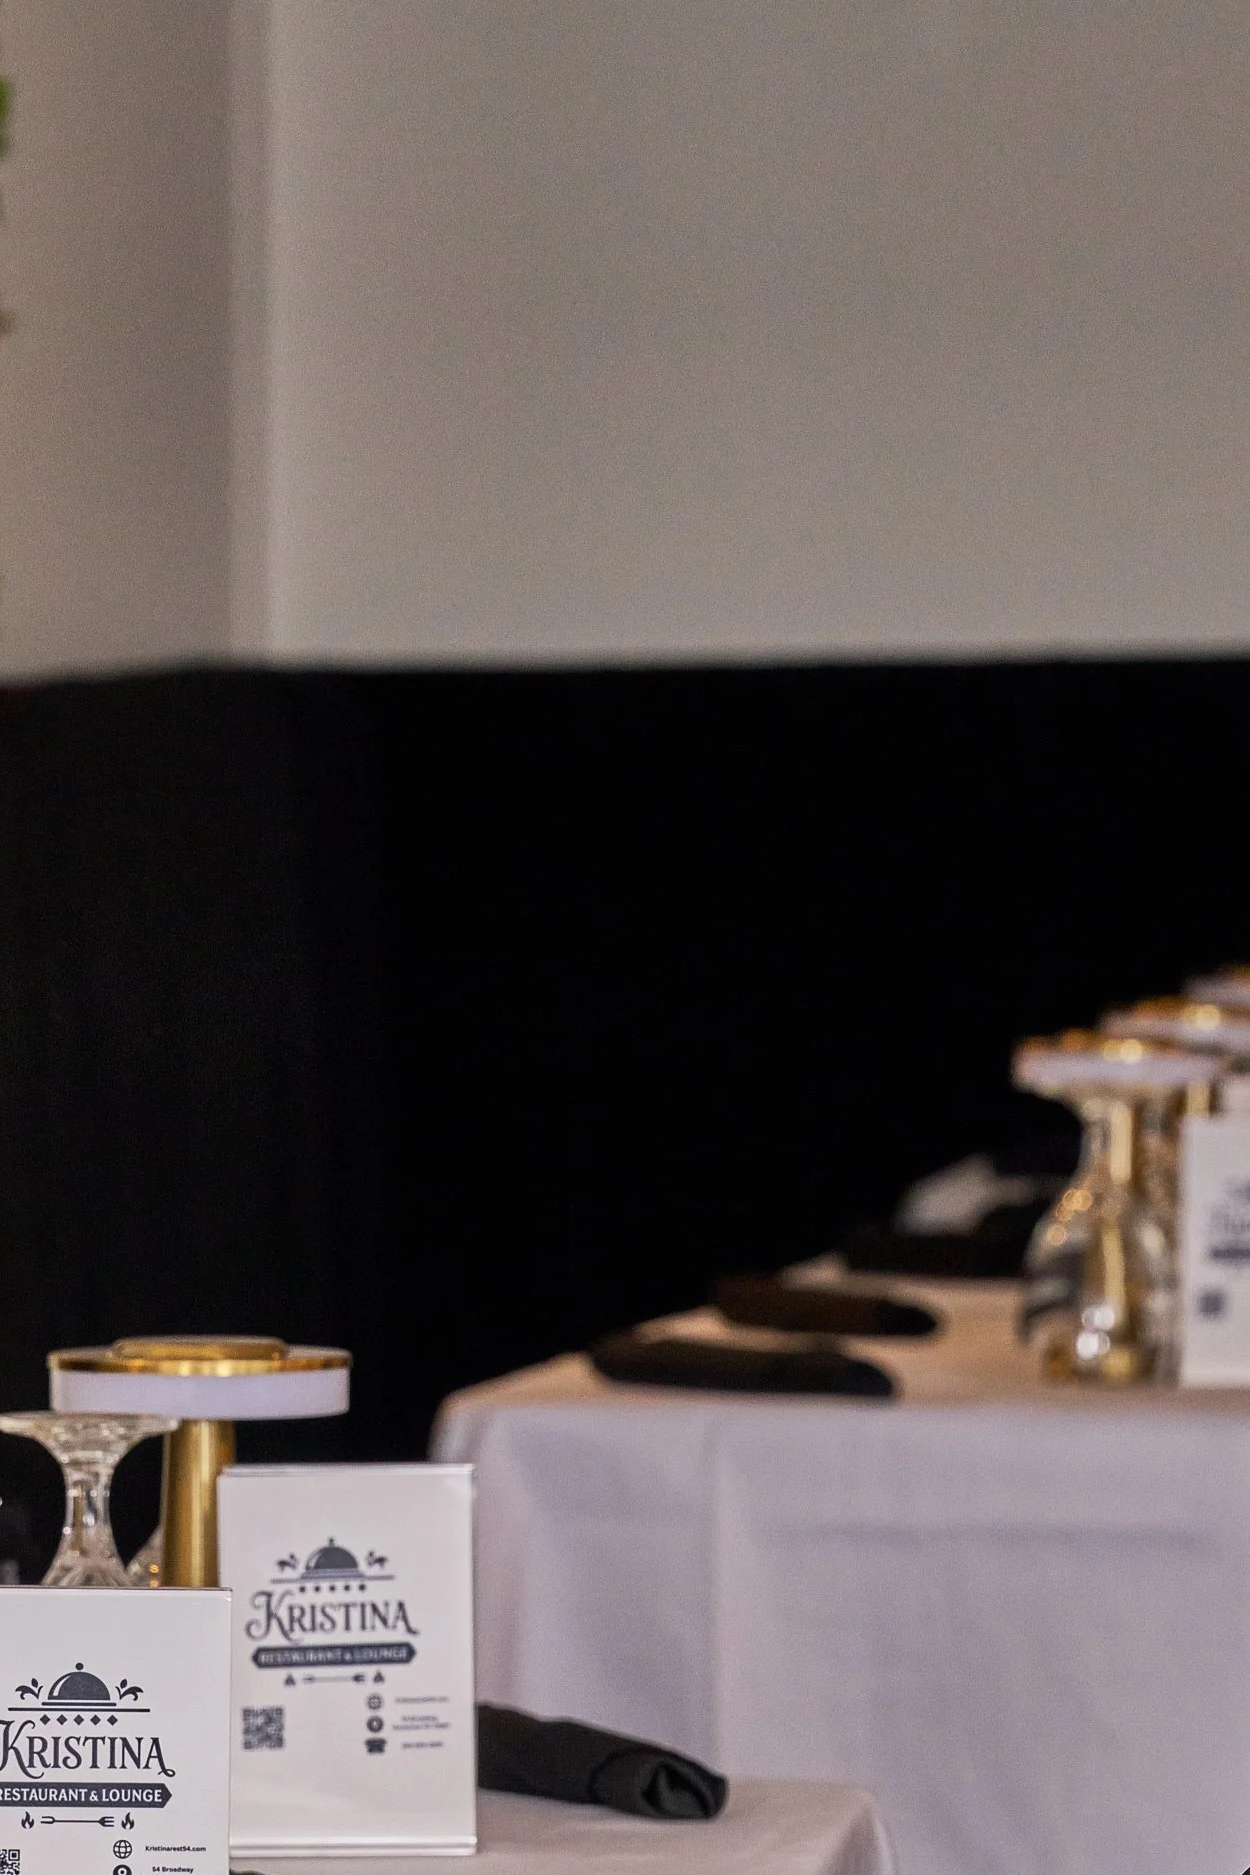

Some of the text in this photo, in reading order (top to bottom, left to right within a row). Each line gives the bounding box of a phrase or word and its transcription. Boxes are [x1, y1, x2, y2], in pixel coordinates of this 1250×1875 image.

[245, 1589, 421, 1644] KRISTINA
[90, 1791, 99, 1802] &
[102, 1788, 162, 1802] LOUNGE
[162, 1866, 194, 1874] Broadway
